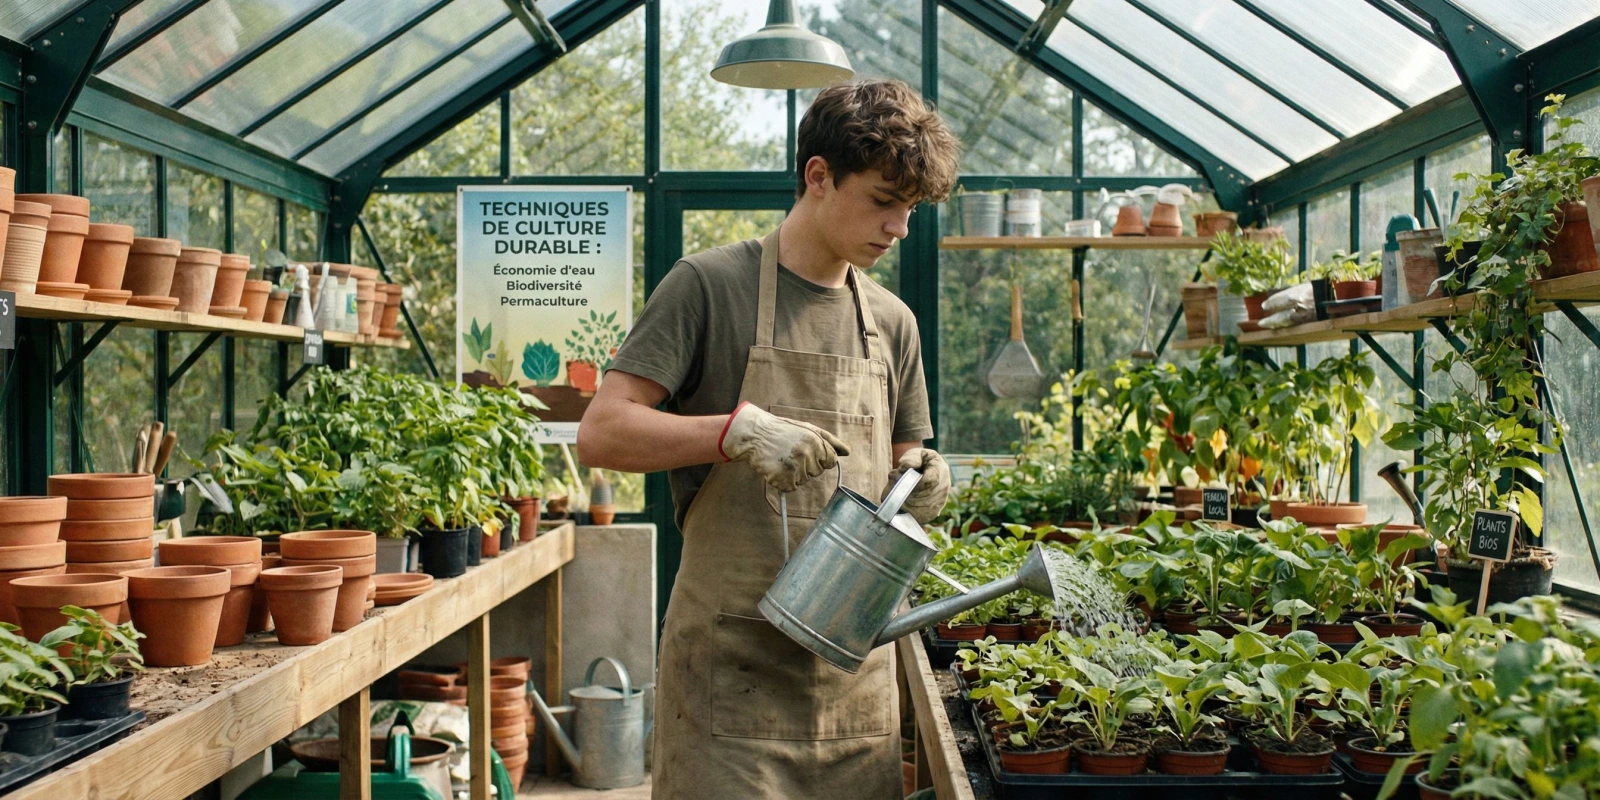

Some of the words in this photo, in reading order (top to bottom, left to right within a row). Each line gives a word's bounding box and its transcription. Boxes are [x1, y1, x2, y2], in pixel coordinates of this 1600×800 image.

[479, 201, 609, 218] TECHNIQUES
[482, 221, 510, 235] DE
[515, 220, 607, 235] CULTURE
[495, 240, 590, 254] DURABLE
[596, 243, 601, 254] :
[493, 263, 557, 275] Économie
[560, 265, 595, 275] d'eau
[506, 280, 583, 291] Biodiversité
[500, 296, 588, 307] Permaculture
[1476, 516, 1507, 533] PLANTS
